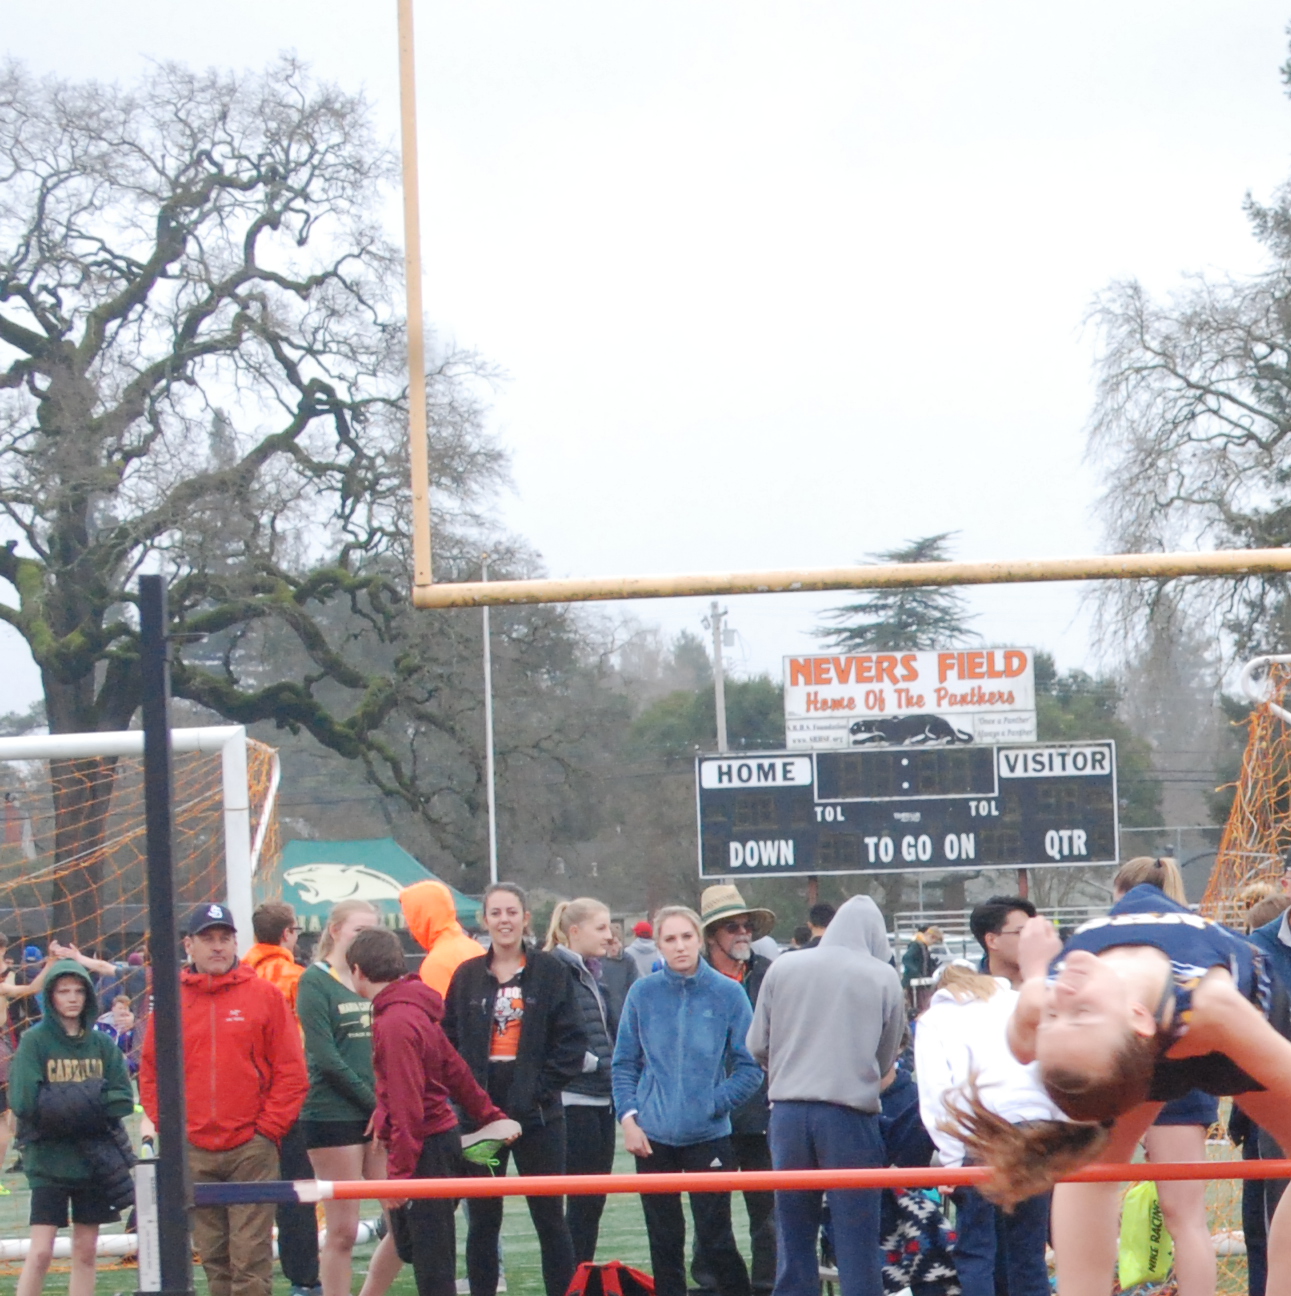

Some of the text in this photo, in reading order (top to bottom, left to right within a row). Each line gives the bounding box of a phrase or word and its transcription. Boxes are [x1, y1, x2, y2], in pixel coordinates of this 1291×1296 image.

[789, 650, 1028, 686] NEVERS FIELD
[806, 685, 1015, 713] Home Of The Panthers
[717, 761, 795, 784] HOME
[1004, 751, 1106, 773] VISITOR
[814, 806, 845, 822] TOL
[969, 800, 999, 817] TOL
[729, 839, 795, 867] DOWN
[864, 832, 976, 863] TO GO ON
[1044, 829, 1087, 860] QTR
[1147, 1245, 1159, 1273] NIKE
